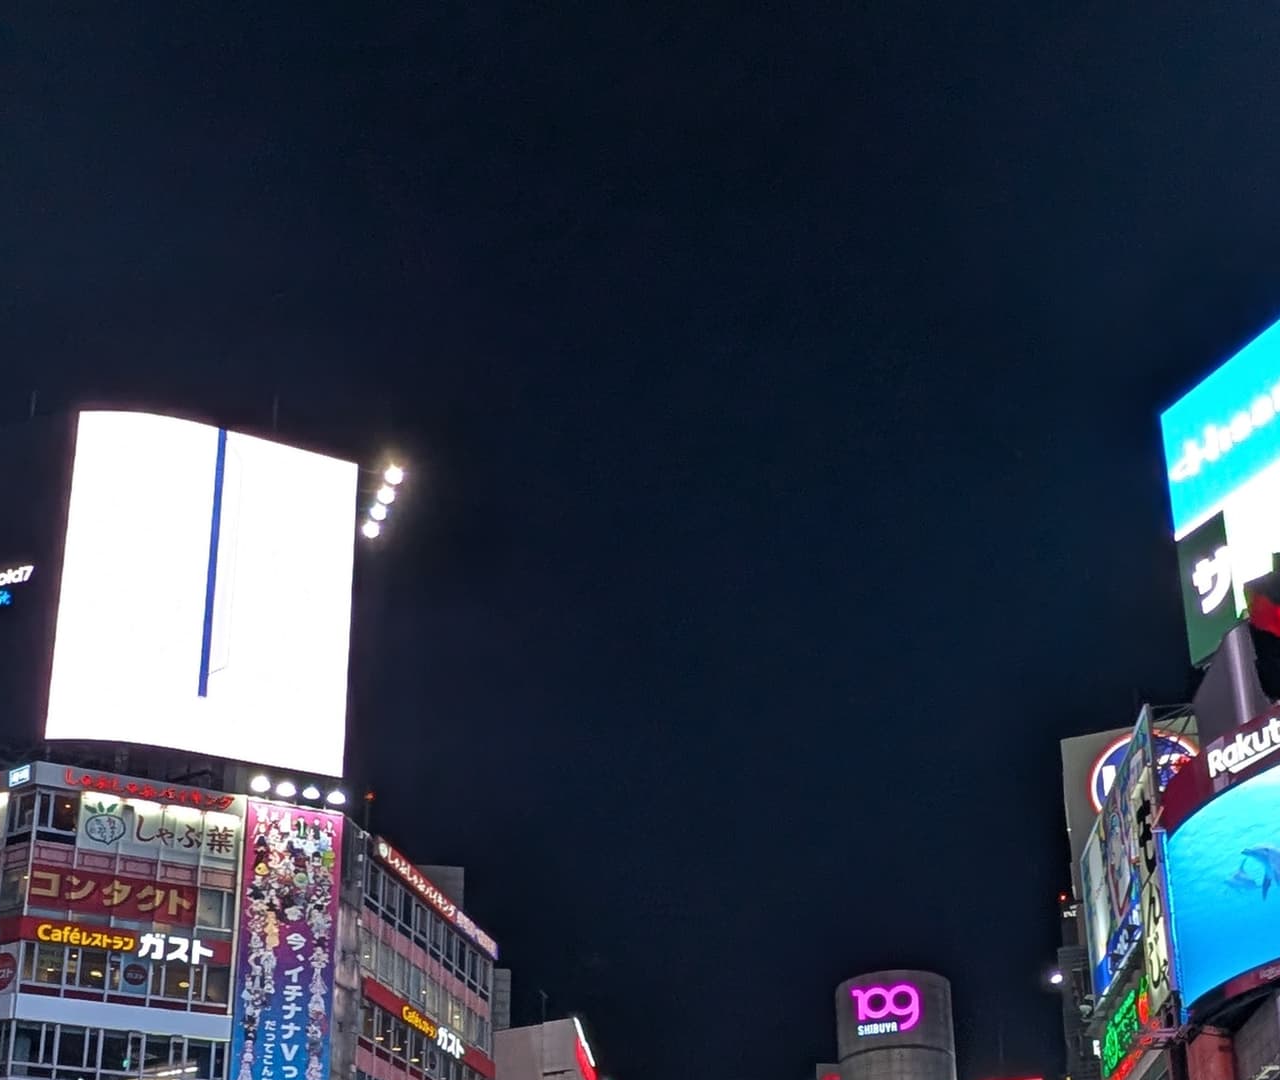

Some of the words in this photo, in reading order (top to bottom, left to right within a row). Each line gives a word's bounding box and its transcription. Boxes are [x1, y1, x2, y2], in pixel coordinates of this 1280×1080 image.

[65, 767, 236, 811] しゃぶしゃぶバイキング
[136, 814, 234, 855] しゃぶ葉
[30, 868, 192, 918] コンタクト
[36, 923, 135, 951] Caféレストラン
[138, 933, 214, 965] ガスト
[851, 984, 920, 1031] 109
[437, 1026, 465, 1060] ガスト
[857, 1021, 898, 1037] SHIBUYA
